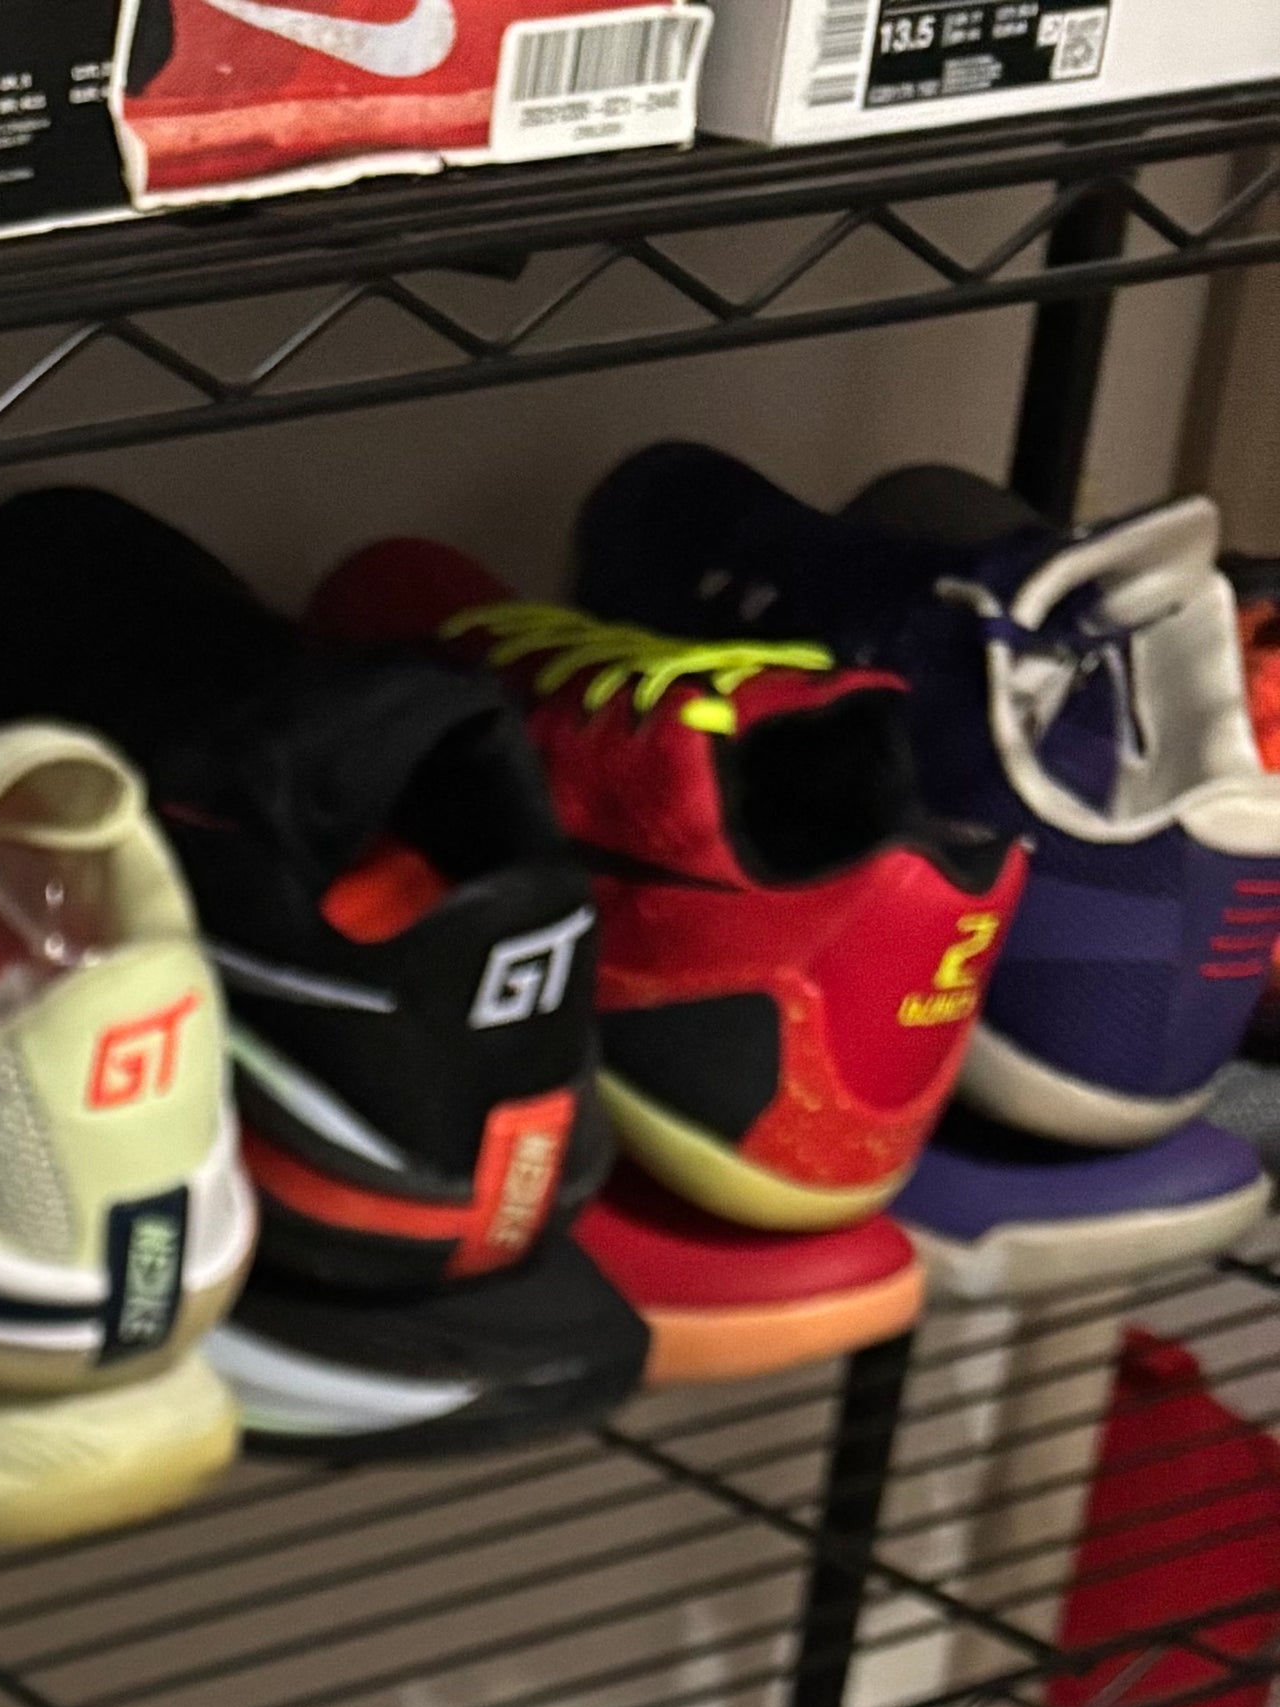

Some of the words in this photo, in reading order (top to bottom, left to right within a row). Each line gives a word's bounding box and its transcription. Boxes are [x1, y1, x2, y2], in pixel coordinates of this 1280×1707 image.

[468, 904, 595, 1029] GT
[932, 910, 999, 989] 2
[84, 989, 203, 1111] GT
